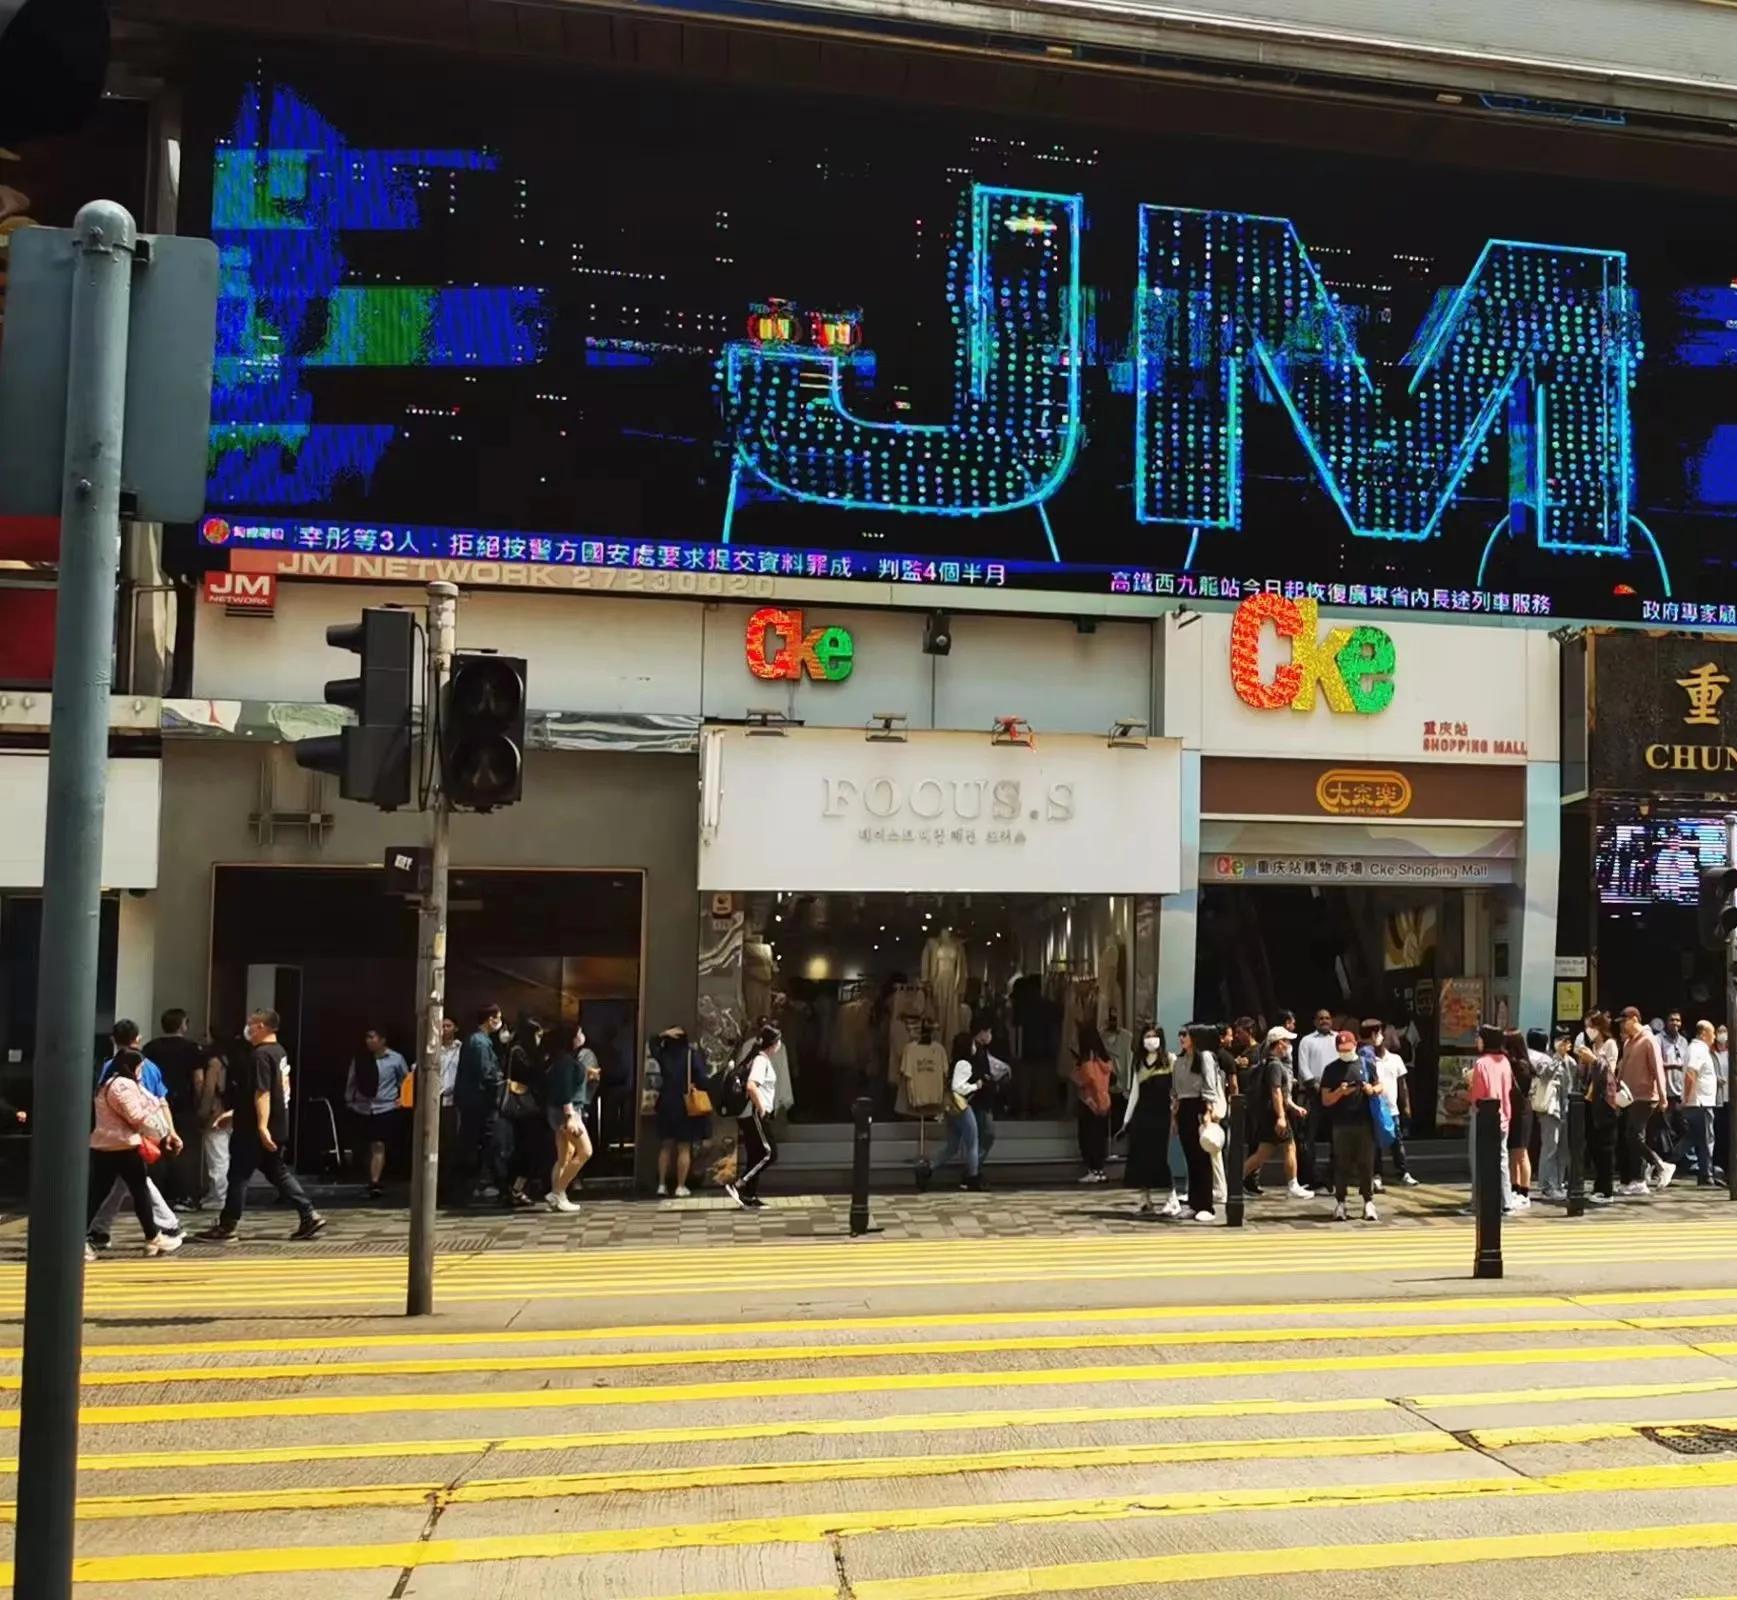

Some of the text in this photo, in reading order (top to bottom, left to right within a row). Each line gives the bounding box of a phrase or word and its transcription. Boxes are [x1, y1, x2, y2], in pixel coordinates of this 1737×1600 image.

[718, 182, 1640, 556] JM
[209, 573, 270, 596] JM
[277, 552, 776, 598] JM NETWORK 27230020
[208, 595, 269, 605] NETWORK
[1423, 738, 1527, 756] SHOPPING MALL
[1370, 863, 1395, 877] Cke
[1398, 863, 1458, 880] Shopping
[1461, 865, 1488, 878] Mall
